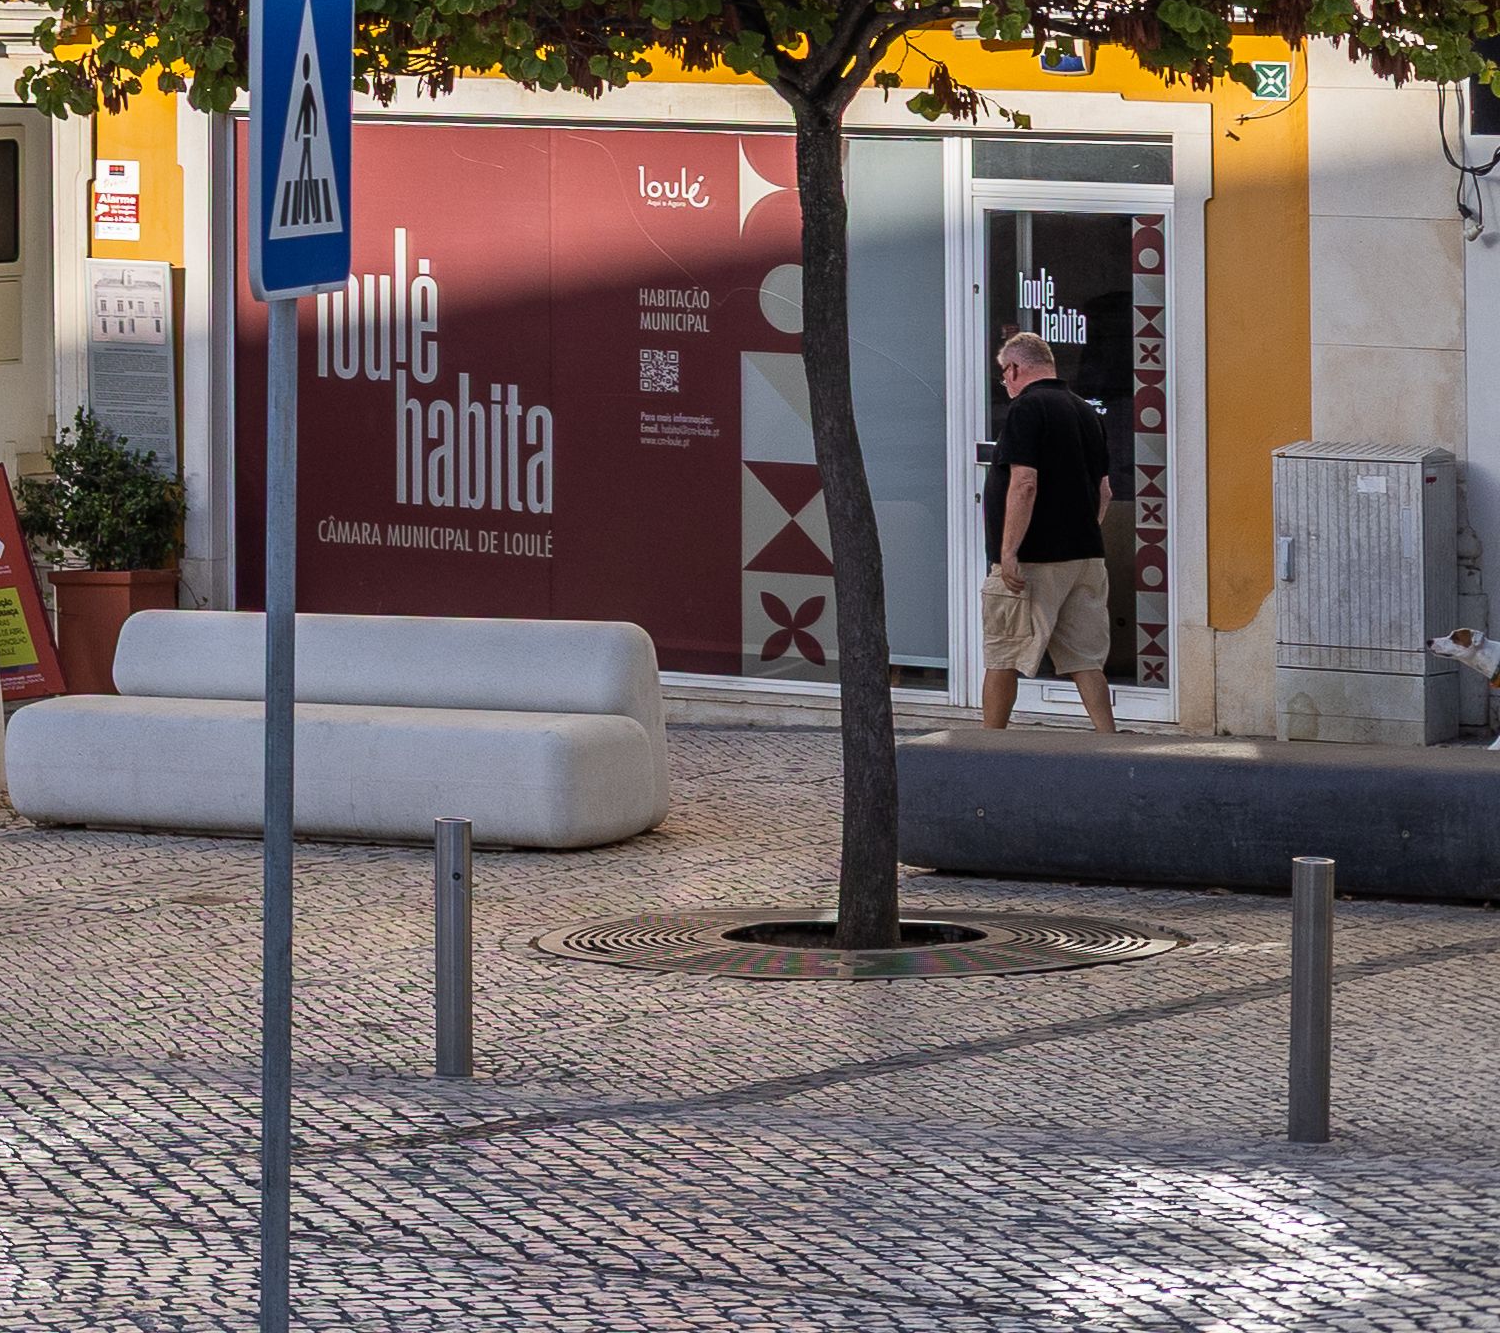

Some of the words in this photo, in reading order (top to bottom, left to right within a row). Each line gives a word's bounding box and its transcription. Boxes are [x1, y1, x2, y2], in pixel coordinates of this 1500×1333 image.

[638, 165, 710, 208] loulé
[640, 286, 710, 311] HABITAÇÃO
[1018, 267, 1054, 309] loulé
[640, 312, 710, 333] MUNICIPAL
[1041, 306, 1087, 344] habita
[641, 411, 655, 421] Para
[657, 413, 672, 422] mais
[396, 369, 554, 514] habita
[318, 515, 382, 547] CÂMARA
[387, 525, 473, 552] MUNICIPAL
[479, 531, 499, 554] DE
[505, 530, 553, 558] LOULÉ
